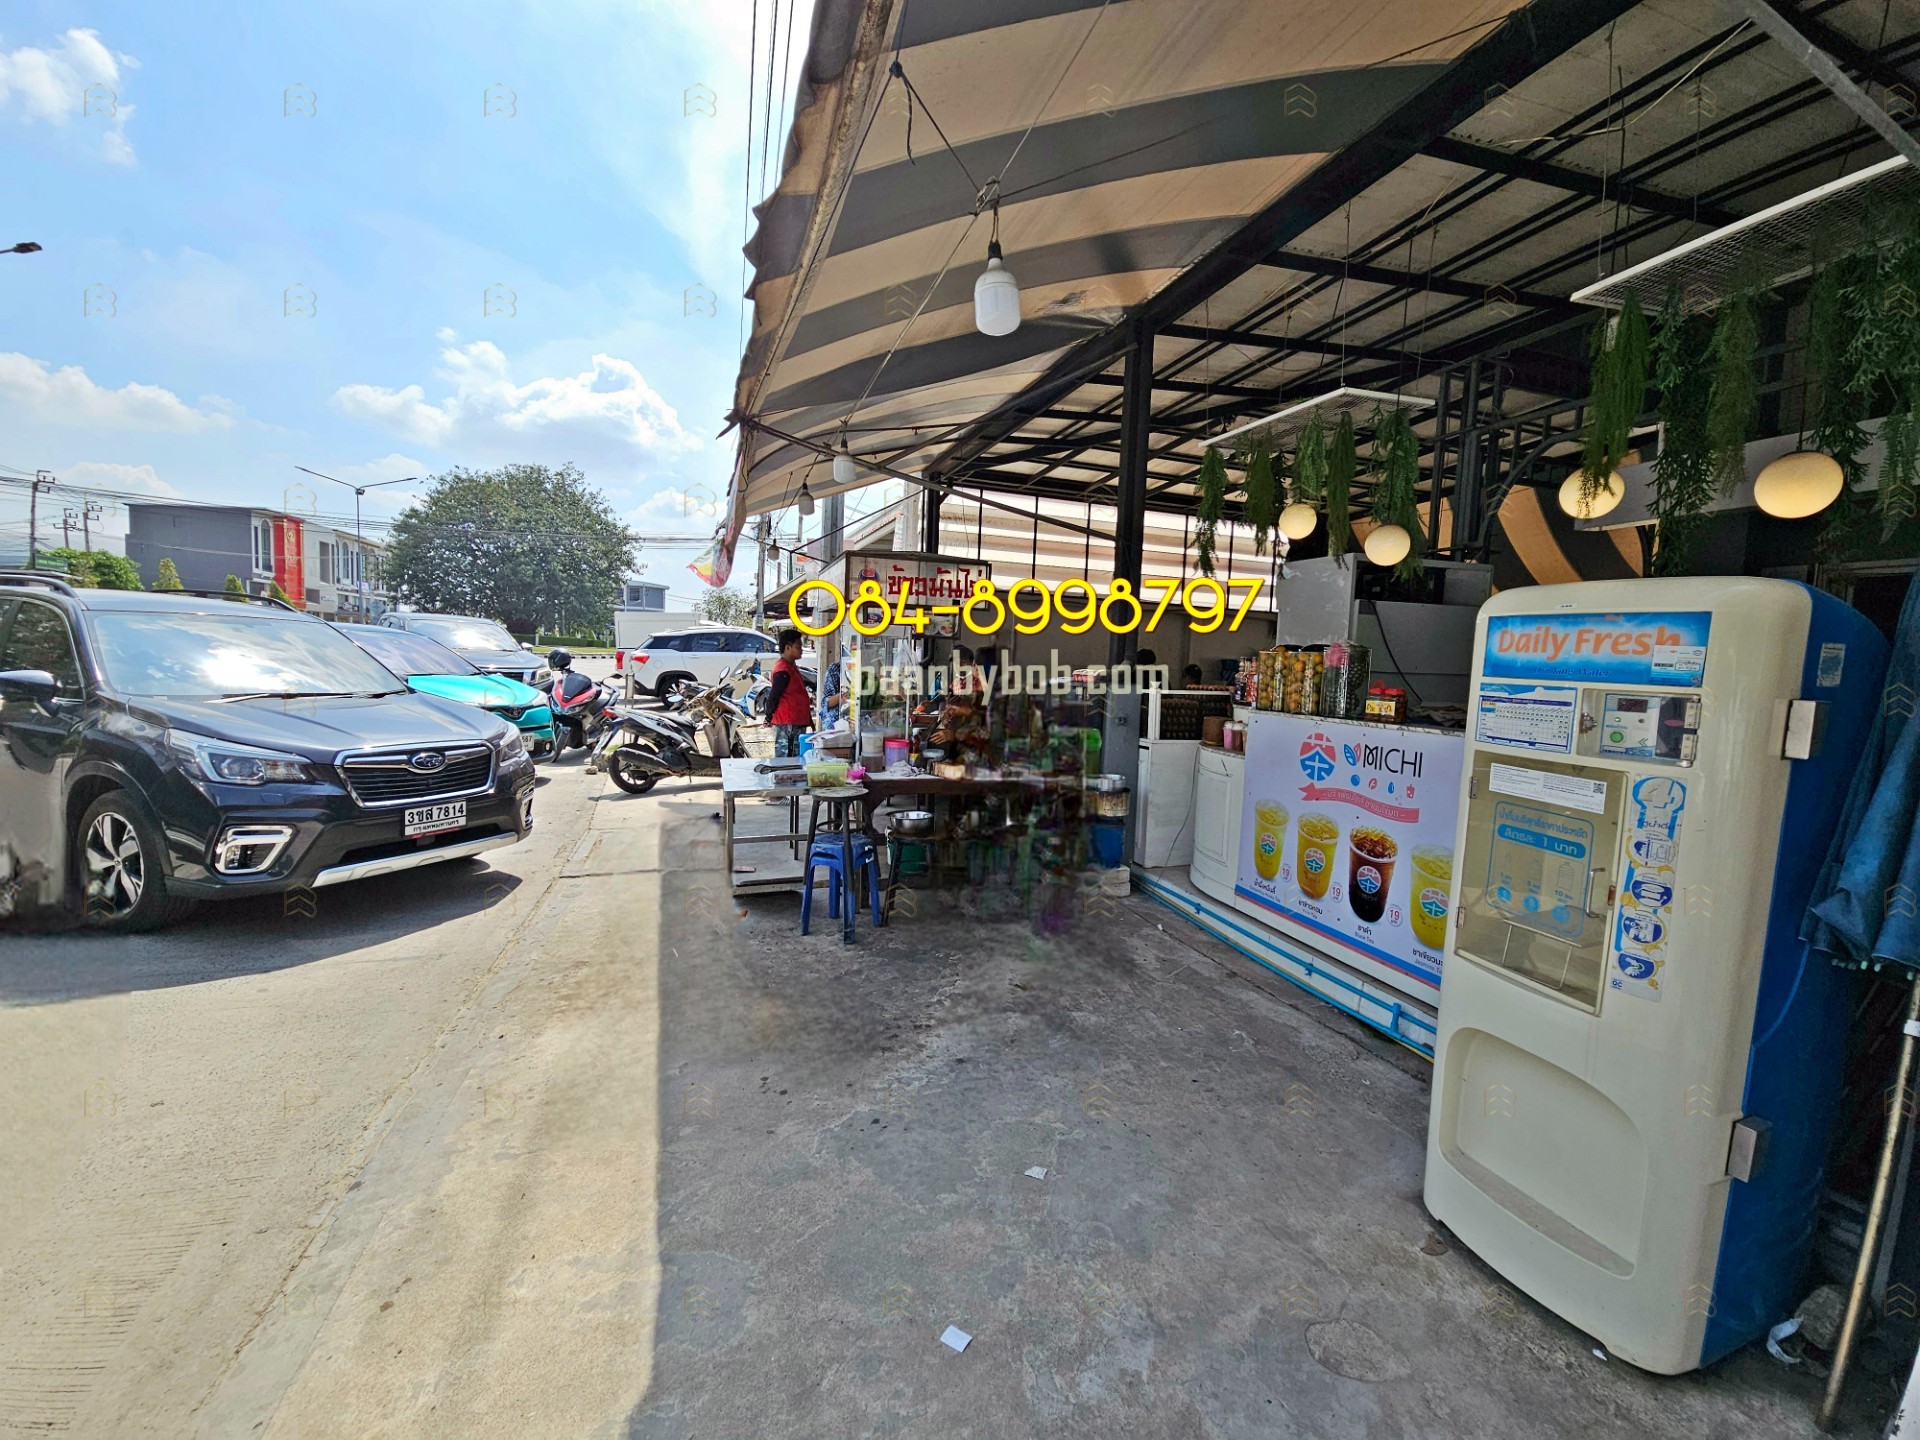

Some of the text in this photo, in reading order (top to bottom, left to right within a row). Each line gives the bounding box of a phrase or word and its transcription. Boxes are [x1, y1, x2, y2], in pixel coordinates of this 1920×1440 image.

[1498, 626, 1681, 661] Daily Fresh
[1362, 744, 1423, 778] MICHI
[407, 803, 465, 824] 3ขส 7814
[1543, 837, 1548, 847] 1
[1554, 842, 1578, 855] บาท
[1332, 886, 1341, 897] 19
[1389, 909, 1400, 920] 19
